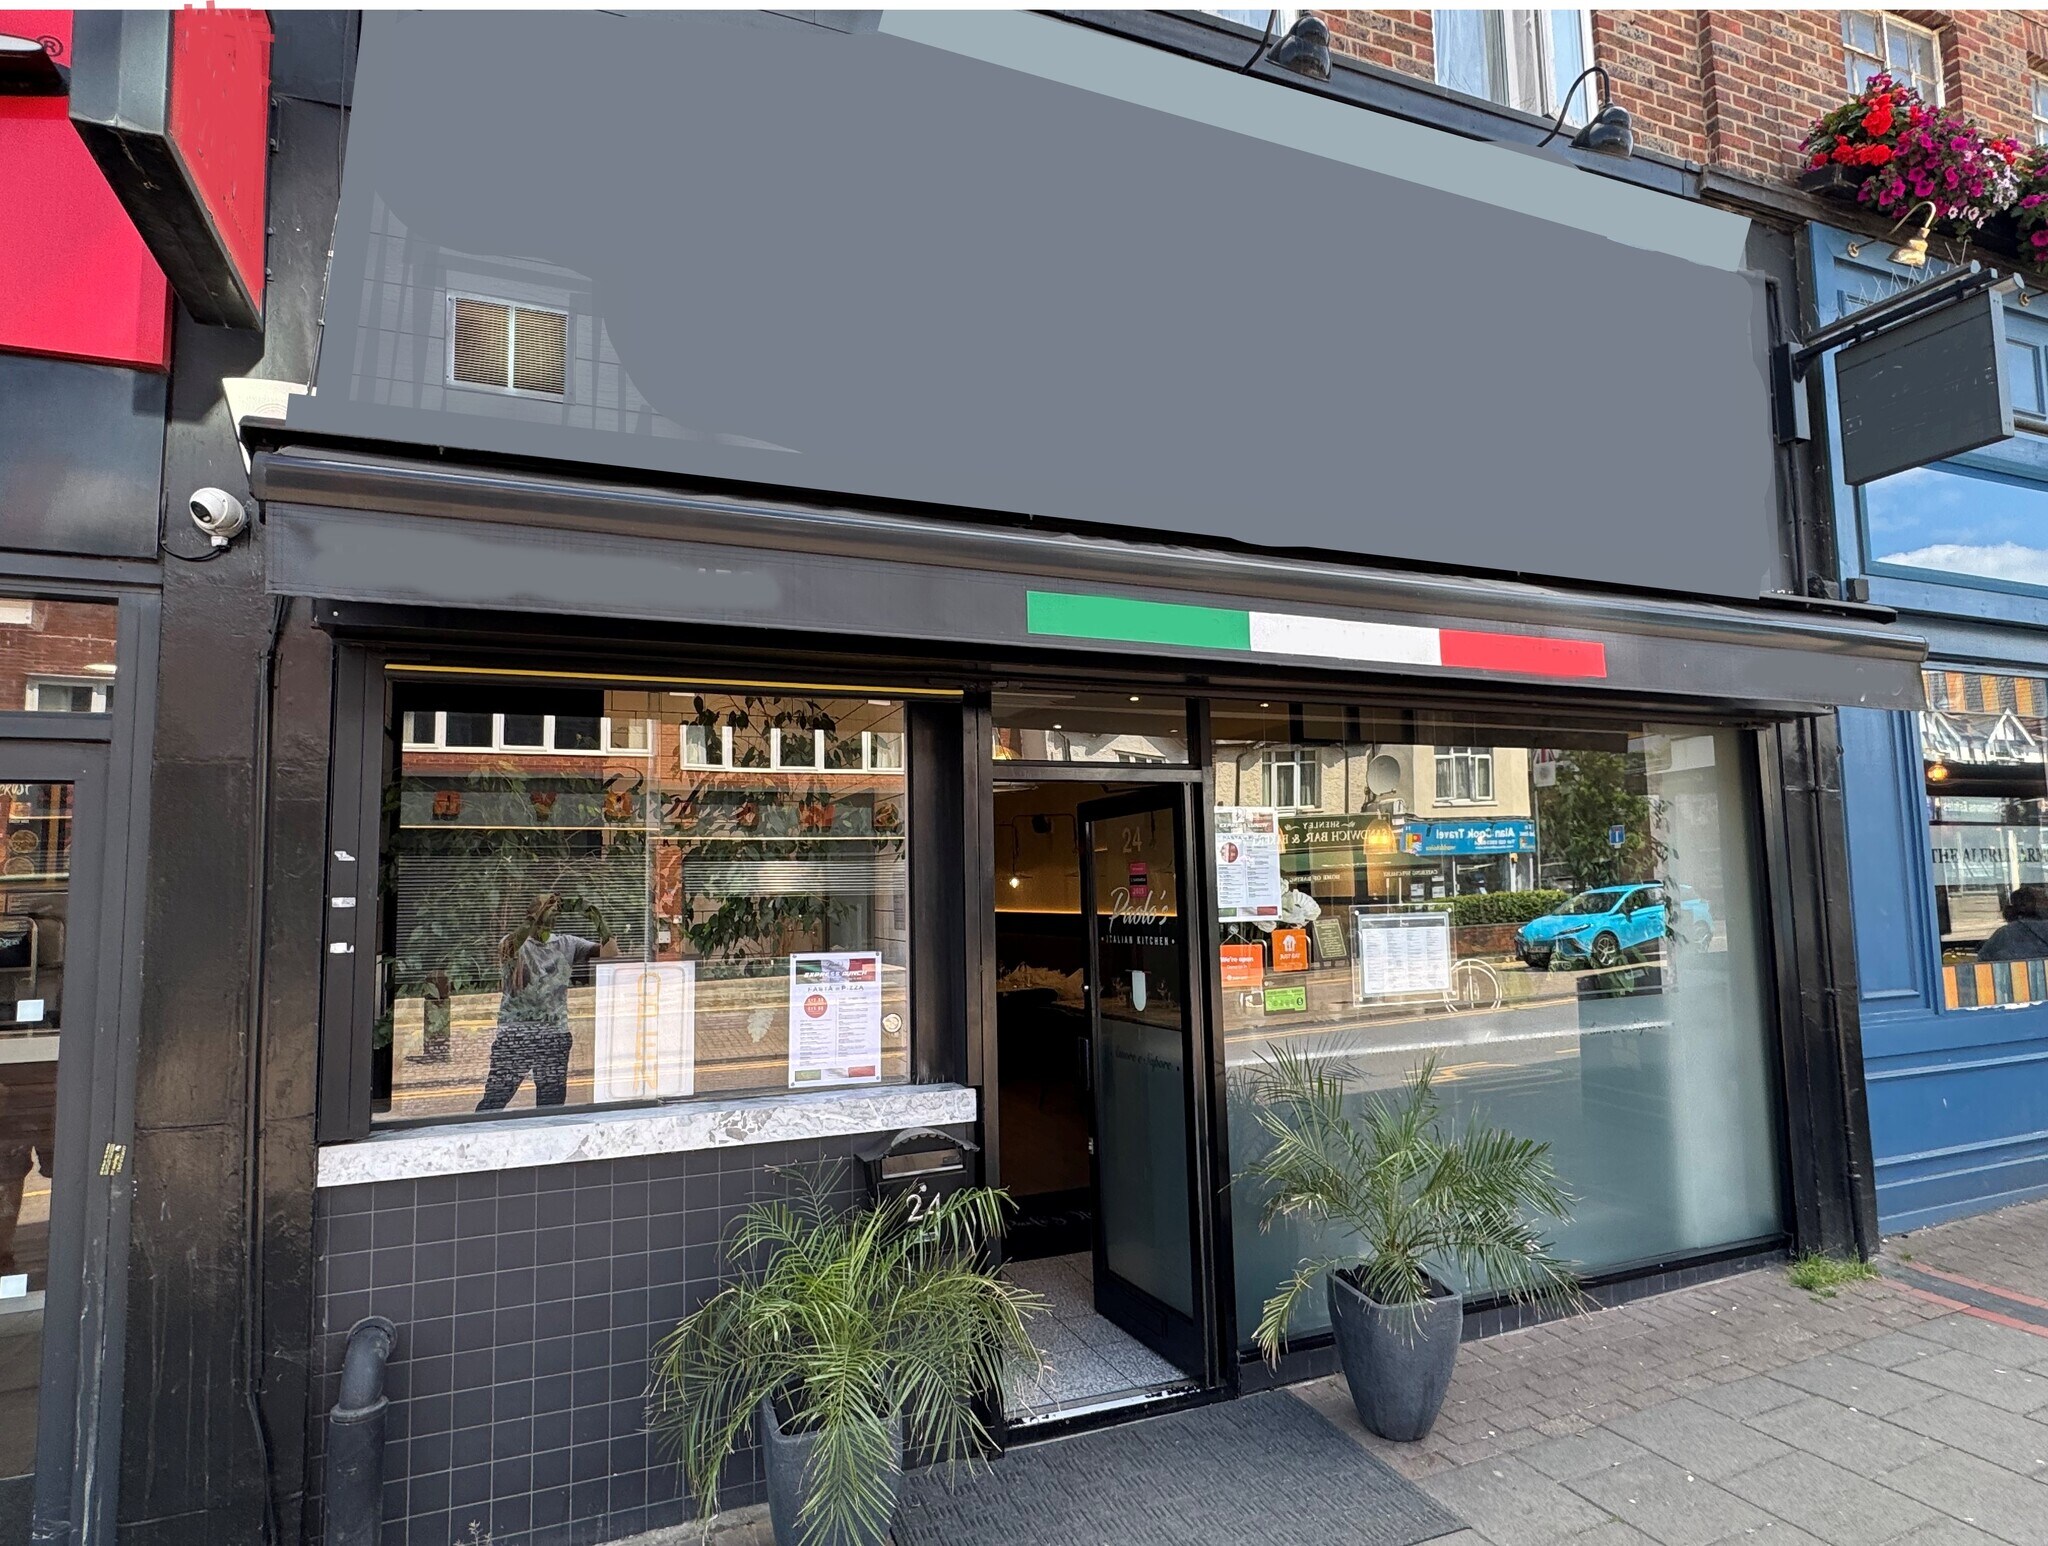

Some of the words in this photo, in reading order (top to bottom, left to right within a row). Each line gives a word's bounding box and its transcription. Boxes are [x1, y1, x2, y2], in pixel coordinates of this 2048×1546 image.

[1122, 826, 1143, 853] 24
[1931, 848, 1959, 864] THE
[1963, 847, 2012, 864] ALFRE
[1109, 886, 1169, 933] Paolo's
[1136, 935, 1169, 946] KITCHEN
[803, 970, 840, 978] EXPRESS
[841, 969, 868, 977] LUNCH
